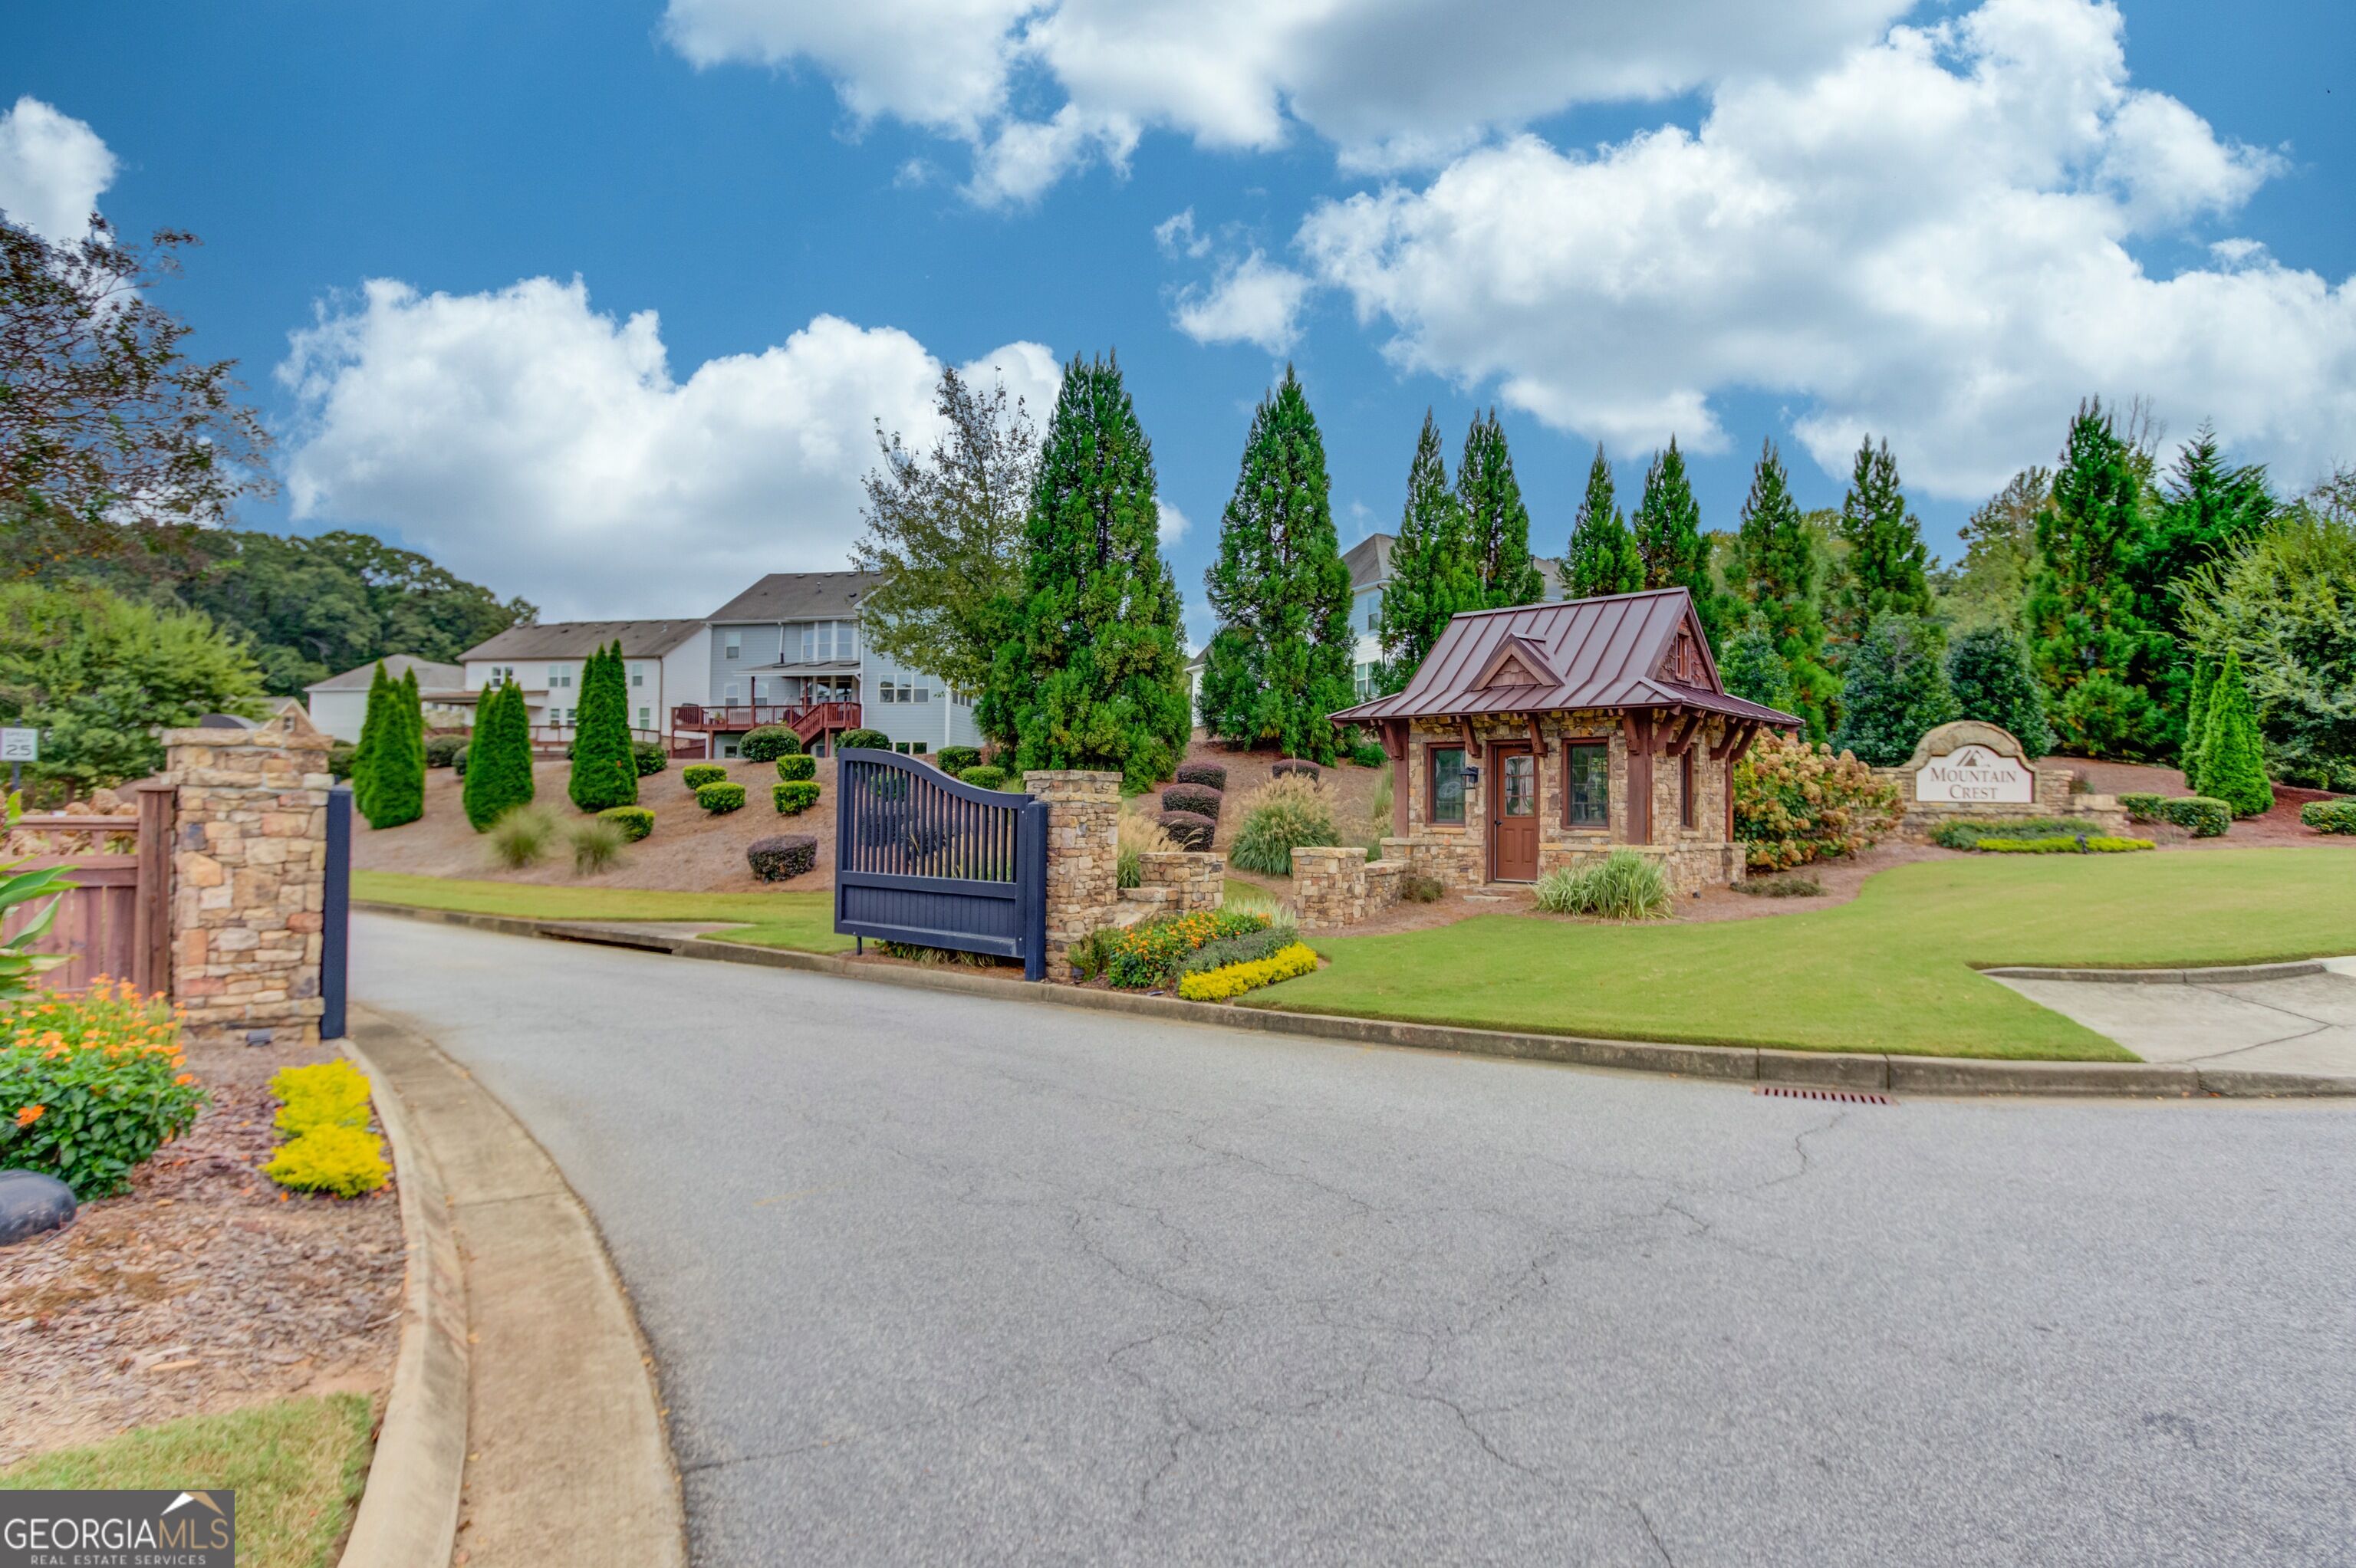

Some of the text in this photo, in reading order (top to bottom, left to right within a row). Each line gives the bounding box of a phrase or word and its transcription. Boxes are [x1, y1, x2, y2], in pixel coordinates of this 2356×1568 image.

[6, 744, 31, 756] 25
[1930, 768, 2016, 783] MOUNTAIN
[1950, 784, 1998, 799] CREST
